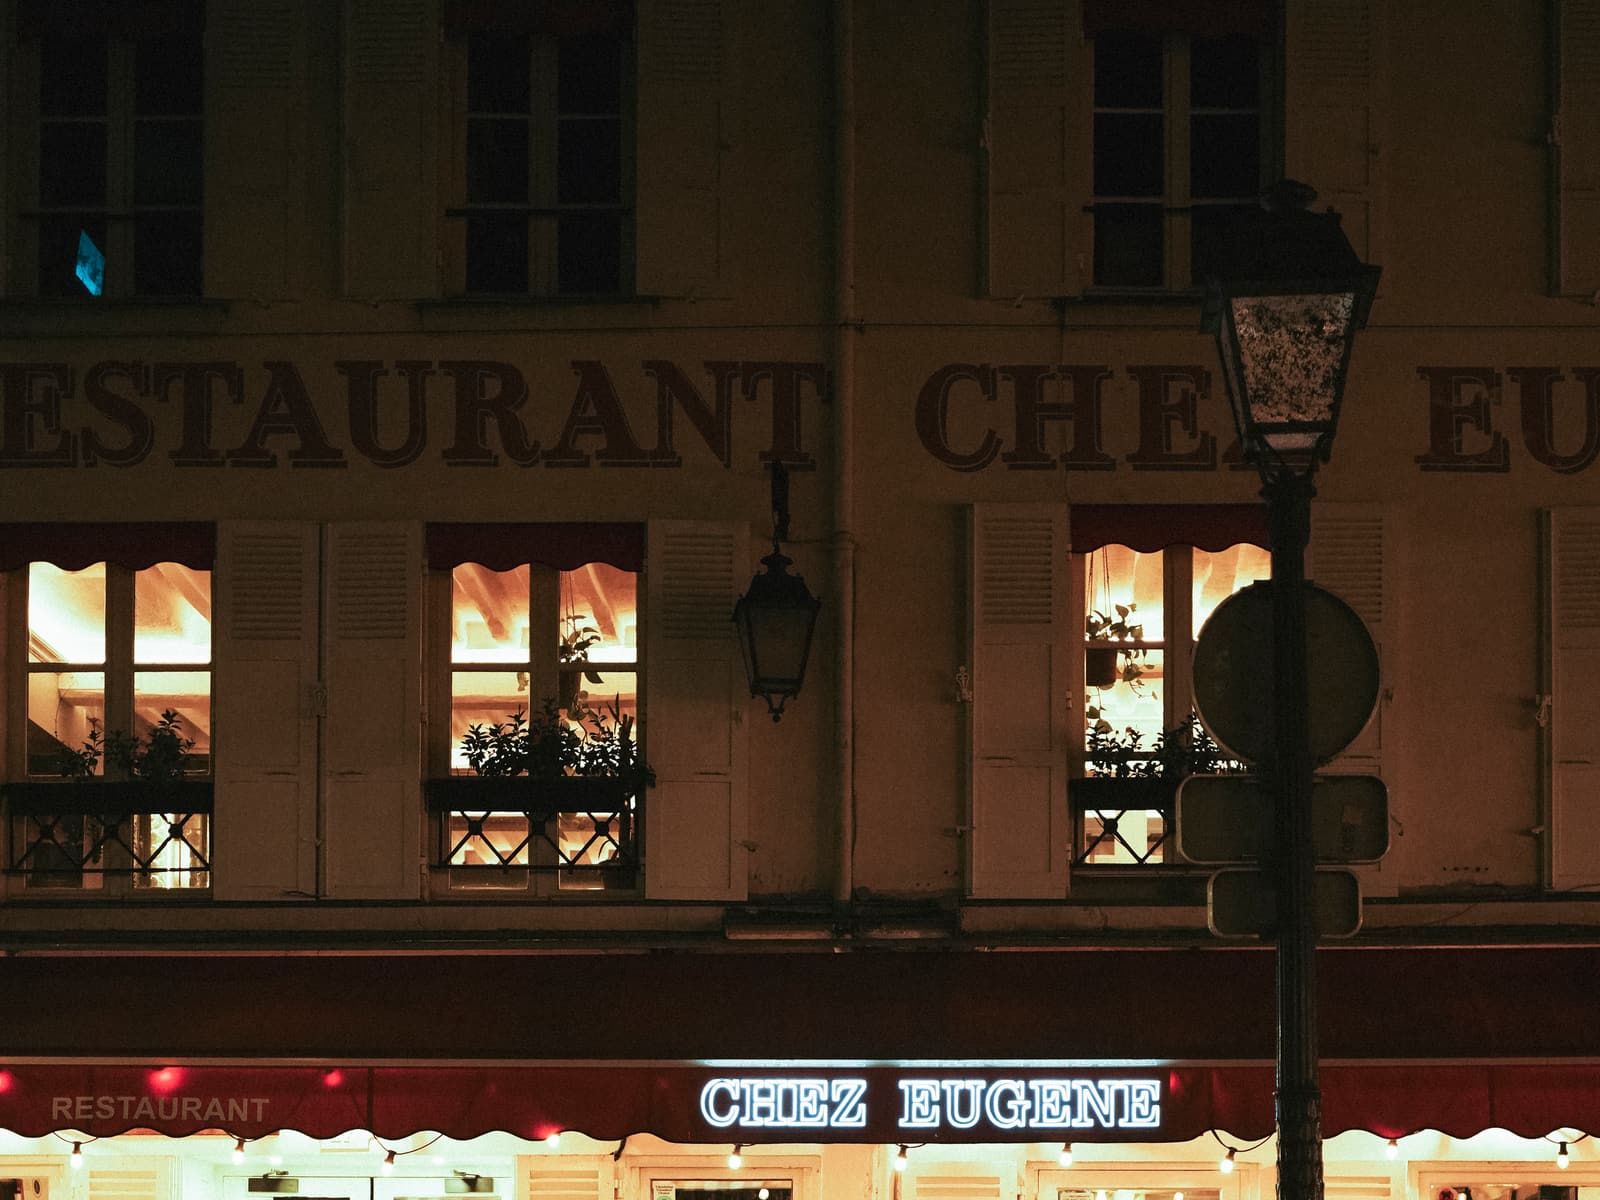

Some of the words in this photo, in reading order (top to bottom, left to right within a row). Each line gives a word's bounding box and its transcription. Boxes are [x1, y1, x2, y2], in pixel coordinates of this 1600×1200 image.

[914, 362, 1320, 473] CHE
[1414, 365, 1600, 474] EU
[51, 1096, 270, 1123] RESTAURANT
[699, 1077, 868, 1129] CHEZ
[898, 1078, 1162, 1129] EUGENE
